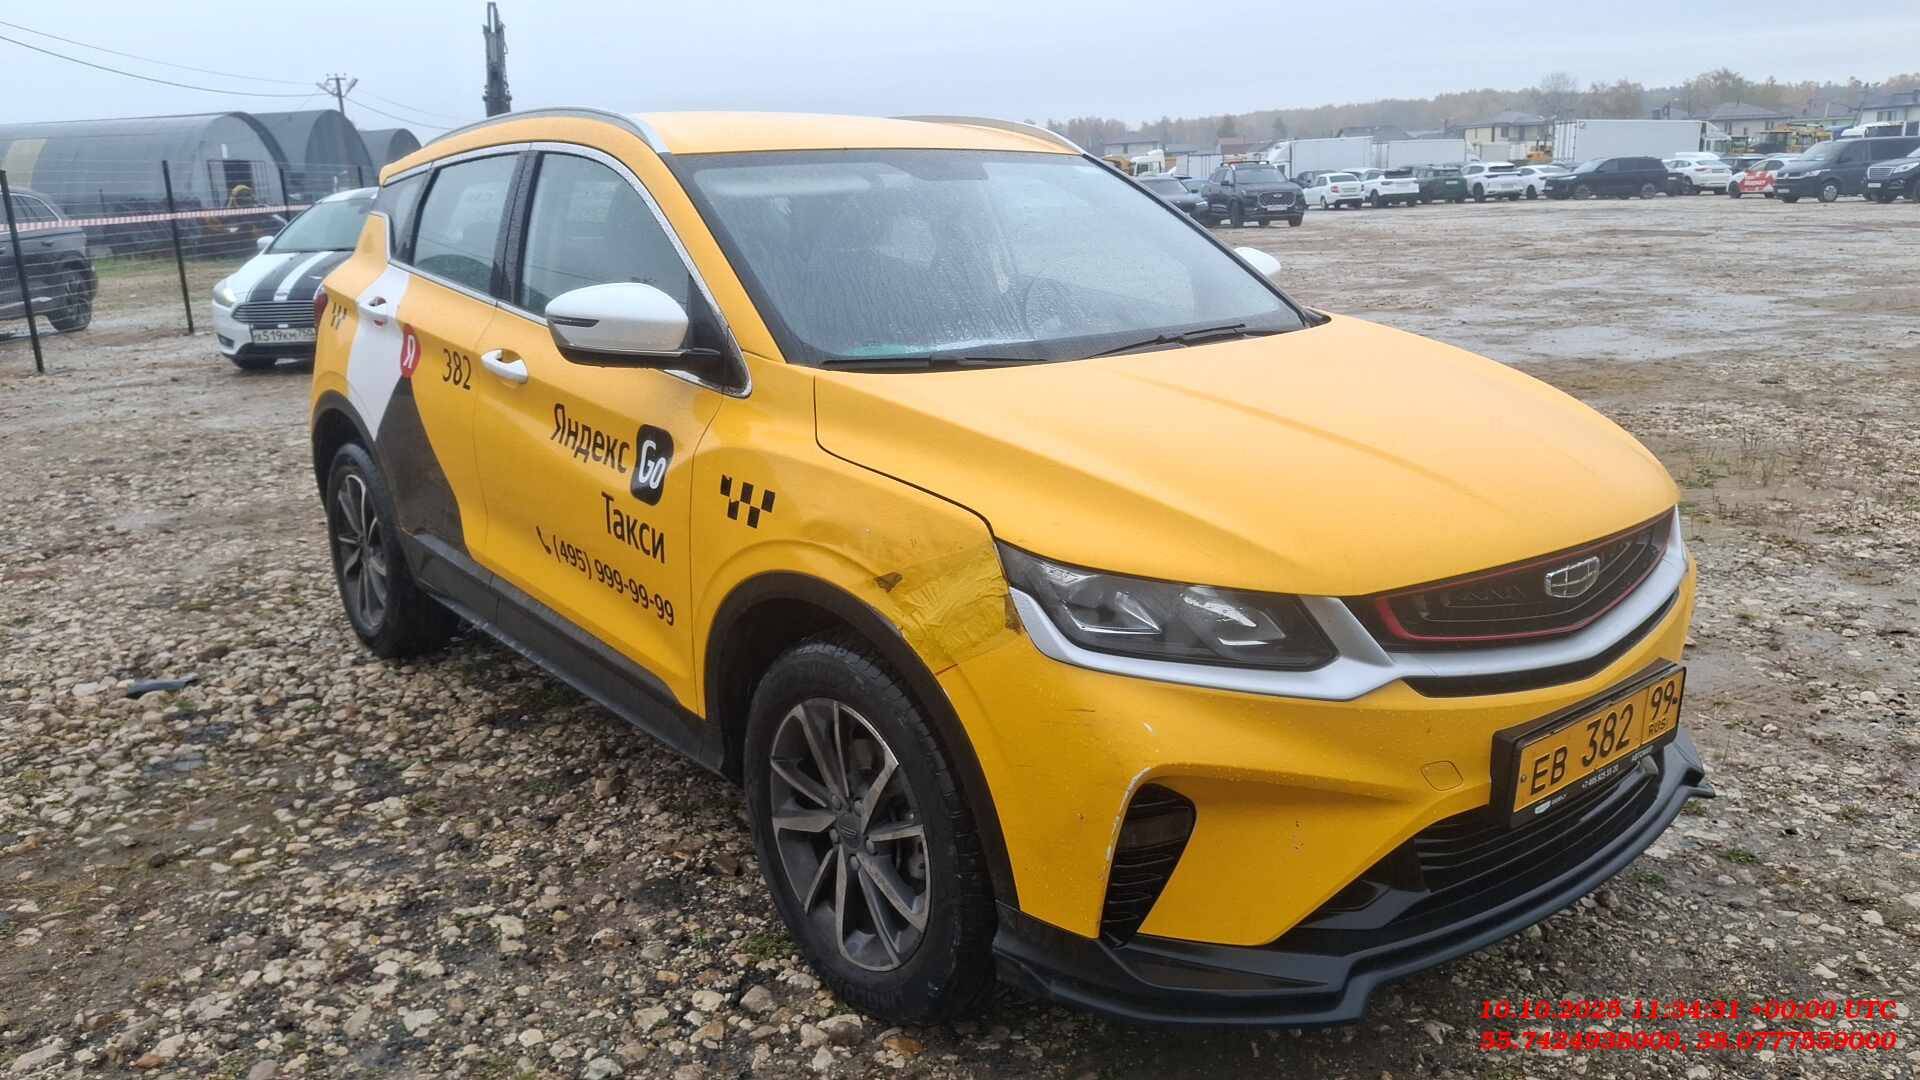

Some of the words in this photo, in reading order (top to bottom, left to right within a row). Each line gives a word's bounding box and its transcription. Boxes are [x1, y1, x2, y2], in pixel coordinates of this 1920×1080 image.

[402, 334, 416, 369] Я
[443, 347, 471, 390] 382
[551, 403, 630, 474] Яндекс
[639, 439, 667, 490] Go
[601, 491, 665, 564] Такси
[552, 534, 592, 581] (495)
[594, 559, 675, 626] 999-99-99
[1580, 703, 1634, 767] 382
[1651, 680, 1675, 720] 99
